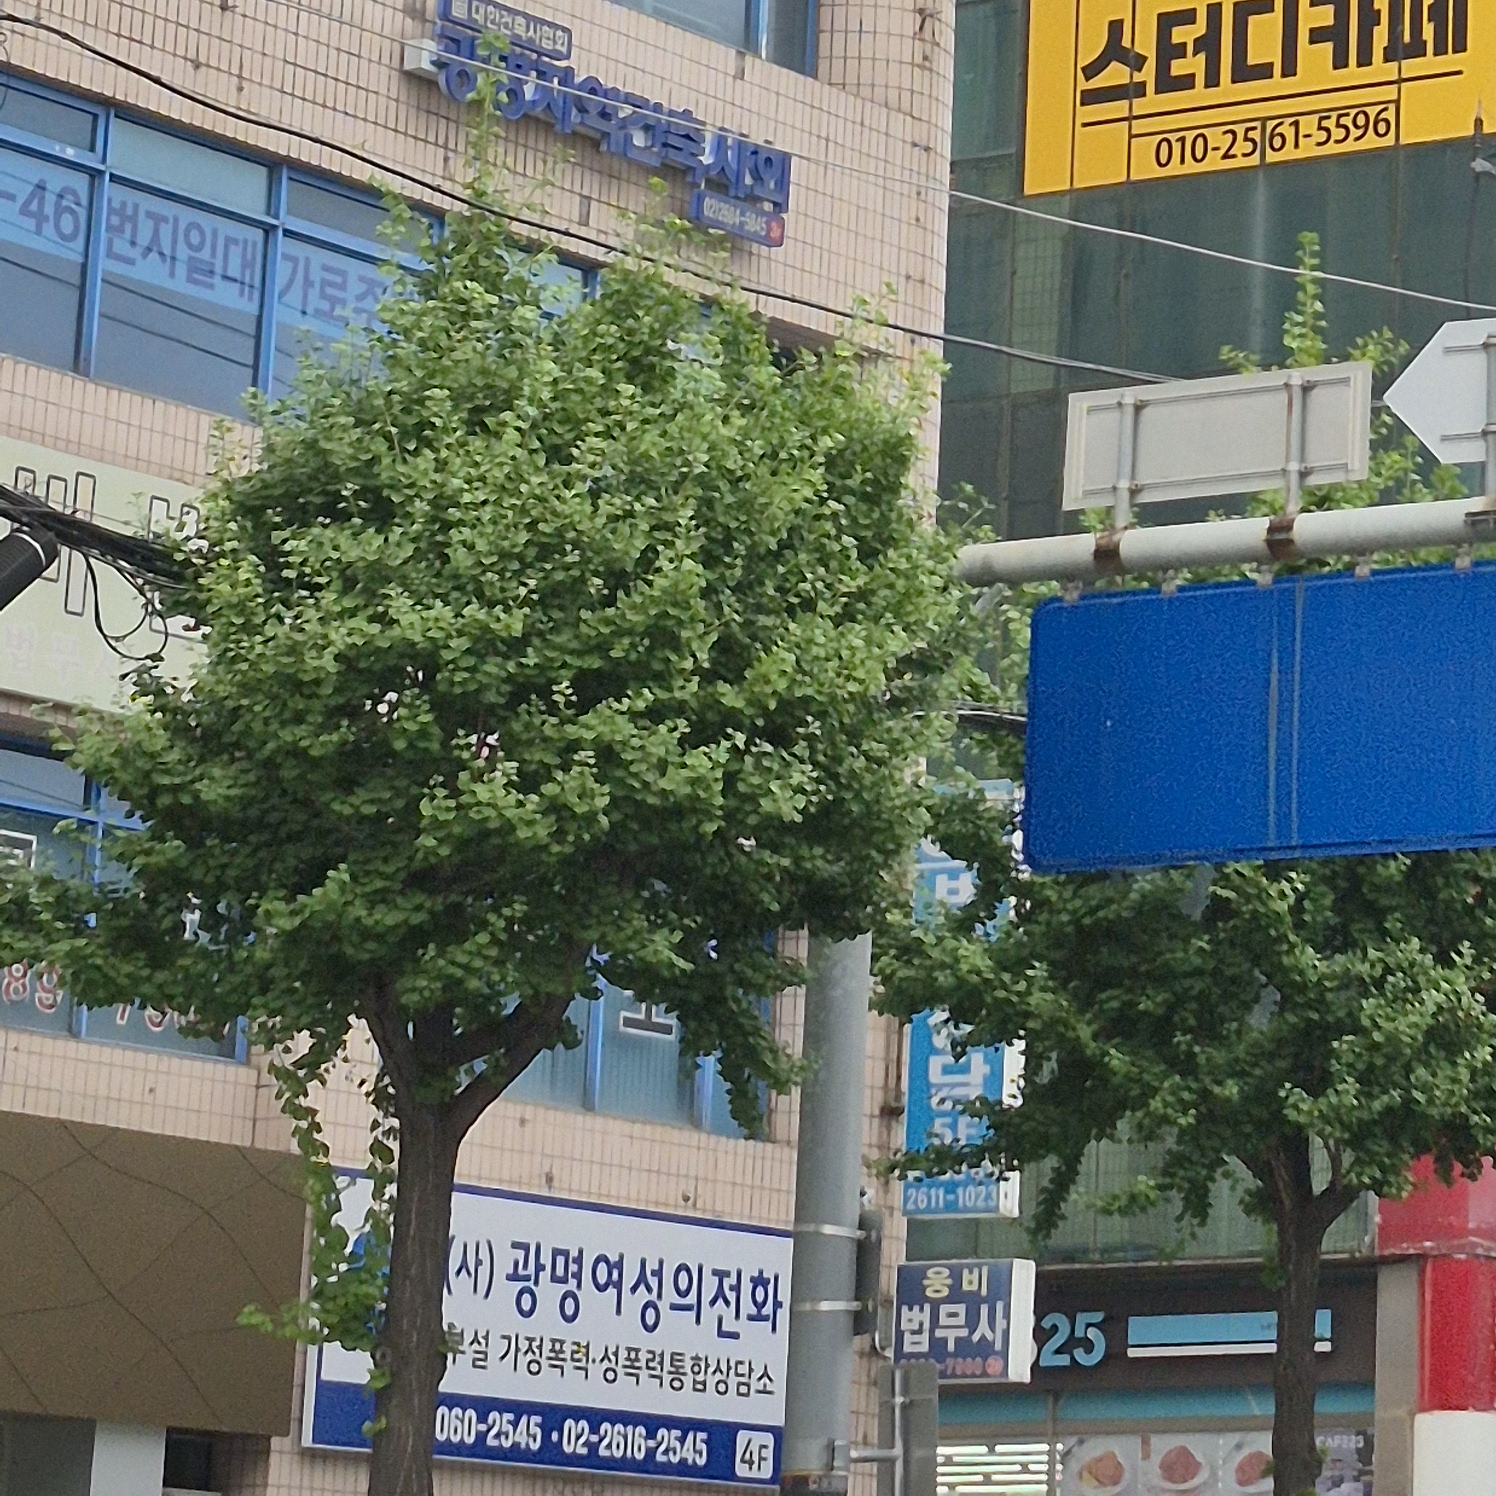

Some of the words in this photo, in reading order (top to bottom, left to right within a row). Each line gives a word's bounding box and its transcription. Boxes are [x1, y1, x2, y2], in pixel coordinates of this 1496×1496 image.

[1155, 106, 1392, 169] 010-2561-5596
[104, 193, 259, 303] 번지일대
[906, 1184, 999, 1211] 2611-1023
[505, 1240, 784, 1340] 광명여성의전화
[900, 1301, 1007, 1354] 법무사
[739, 1437, 770, 1472] 4F
